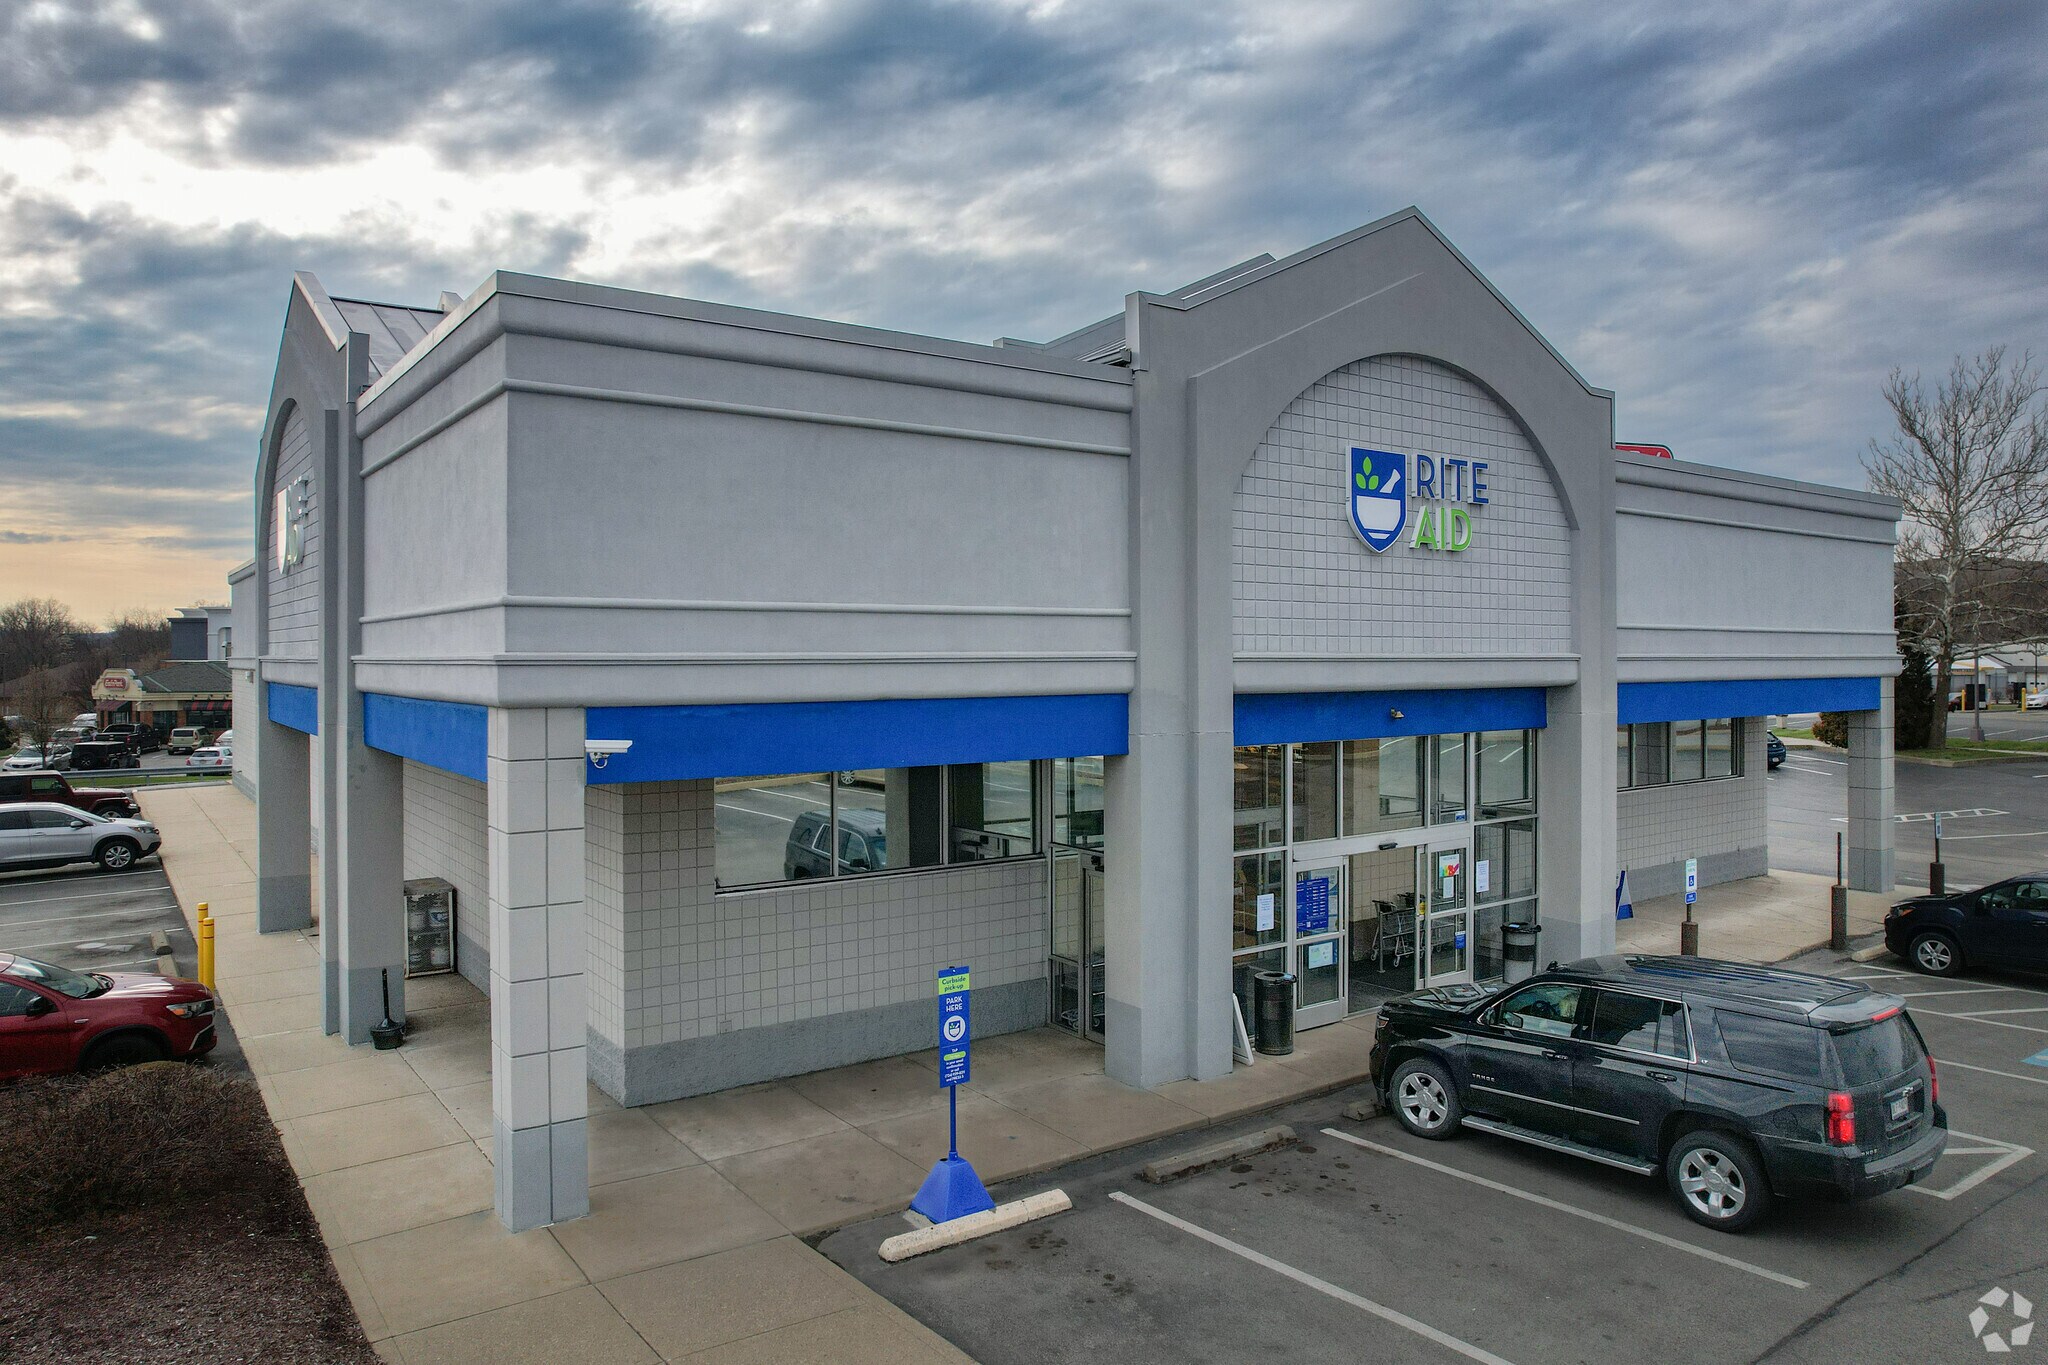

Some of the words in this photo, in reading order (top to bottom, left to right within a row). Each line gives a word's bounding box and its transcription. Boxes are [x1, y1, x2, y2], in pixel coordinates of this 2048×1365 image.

[1412, 454, 1489, 504] RITE
[1409, 506, 1472, 551] AID
[942, 976, 966, 986] Curbside
[946, 995, 963, 1004] PARK
[946, 1003, 963, 1012] HERE
